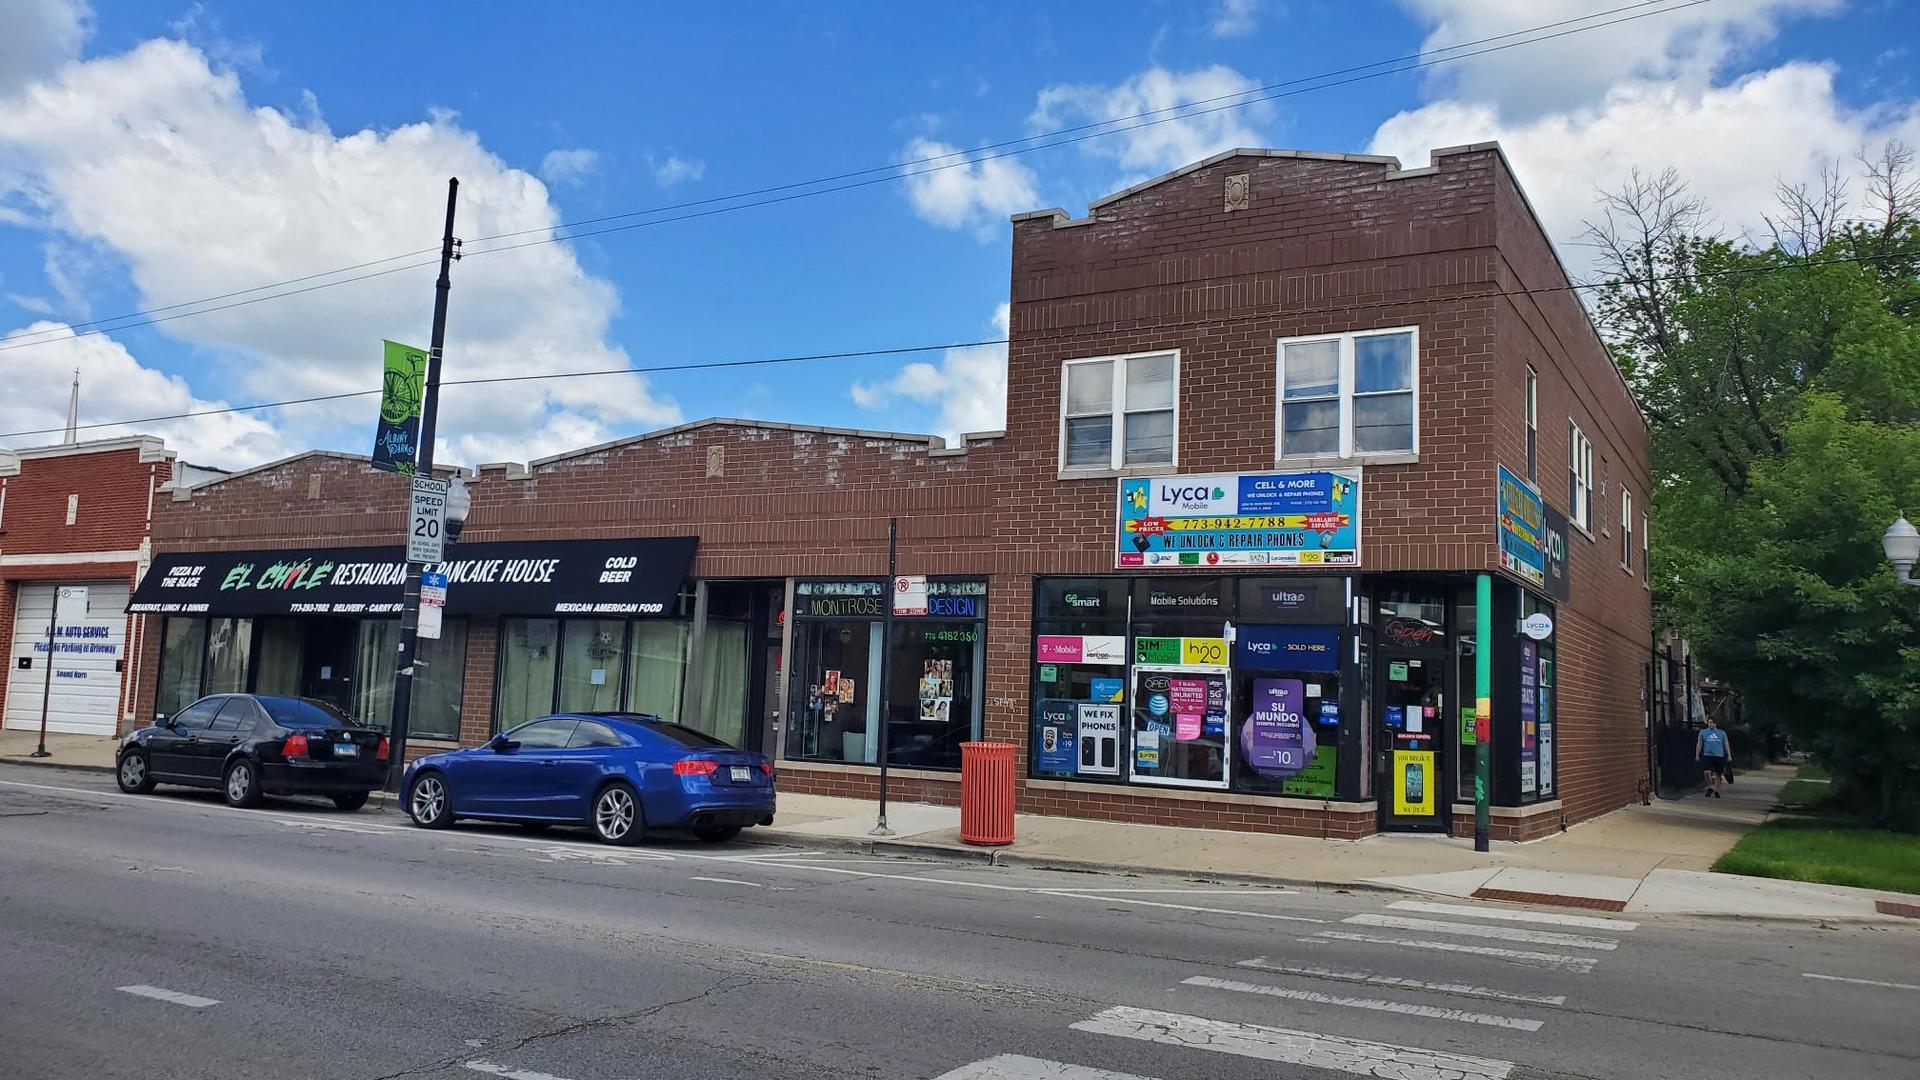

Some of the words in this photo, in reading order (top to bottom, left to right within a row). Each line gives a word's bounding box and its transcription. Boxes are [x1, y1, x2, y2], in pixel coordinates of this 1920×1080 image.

[414, 480, 446, 492] SCHOOL
[1255, 481, 1277, 490] CELL
[1278, 481, 1286, 489] &
[1287, 479, 1316, 489] MORE
[414, 495, 443, 506] SPEED
[1162, 485, 1209, 505] Lyca
[416, 506, 439, 517] LIMIT
[1182, 502, 1209, 510] Mobile
[415, 518, 439, 538] 20
[1183, 517, 1286, 529] 773-942-7788
[1163, 535, 1177, 548] WE
[1180, 534, 1215, 548] UNLOCK
[1229, 532, 1263, 547] REPAIR
[1267, 532, 1304, 547] PHONES
[1543, 517, 1561, 563] Lyca
[605, 556, 637, 569] COLD
[168, 566, 193, 576] PIZZA
[191, 565, 207, 576] BY
[220, 562, 256, 592] EL
[256, 558, 335, 591] CHILE
[331, 562, 408, 586] RESTAURAN
[500, 559, 560, 583] HOUSE
[161, 577, 179, 588] THE
[176, 576, 202, 588] SLICE
[599, 570, 632, 583] BEER
[1150, 596, 1177, 606] Mobile
[1177, 596, 1219, 606] Solutions
[1272, 591, 1297, 602] ultra
[161, 603, 181, 612] LUNCH
[187, 603, 210, 612] DINNER
[332, 603, 366, 613] DELIVERY
[368, 603, 393, 613] CARRY
[391, 603, 404, 612] OU
[555, 602, 593, 613] MEXICAN
[592, 602, 639, 613] AMERICAN
[637, 603, 663, 613] FOOD
[811, 597, 883, 616] MONTROSE
[928, 598, 975, 616] DESIGN
[1072, 598, 1100, 607] smart
[65, 626, 82, 638] AUTO
[82, 626, 109, 639] SERVICE
[61, 642, 83, 654] Parking
[90, 643, 117, 654] Driveway
[1248, 641, 1271, 652] Lyca
[1287, 643, 1306, 651] SOLD
[1307, 644, 1326, 652] HERE
[56, 670, 74, 678] Sound
[1210, 690, 1222, 698] 5G
[1271, 702, 1286, 712] SU
[1043, 710, 1066, 722] Lyca
[1084, 710, 1098, 718] WE
[1100, 711, 1114, 719] FIX
[1081, 722, 1116, 731] PHONES
[1149, 722, 1169, 734] OPEN
